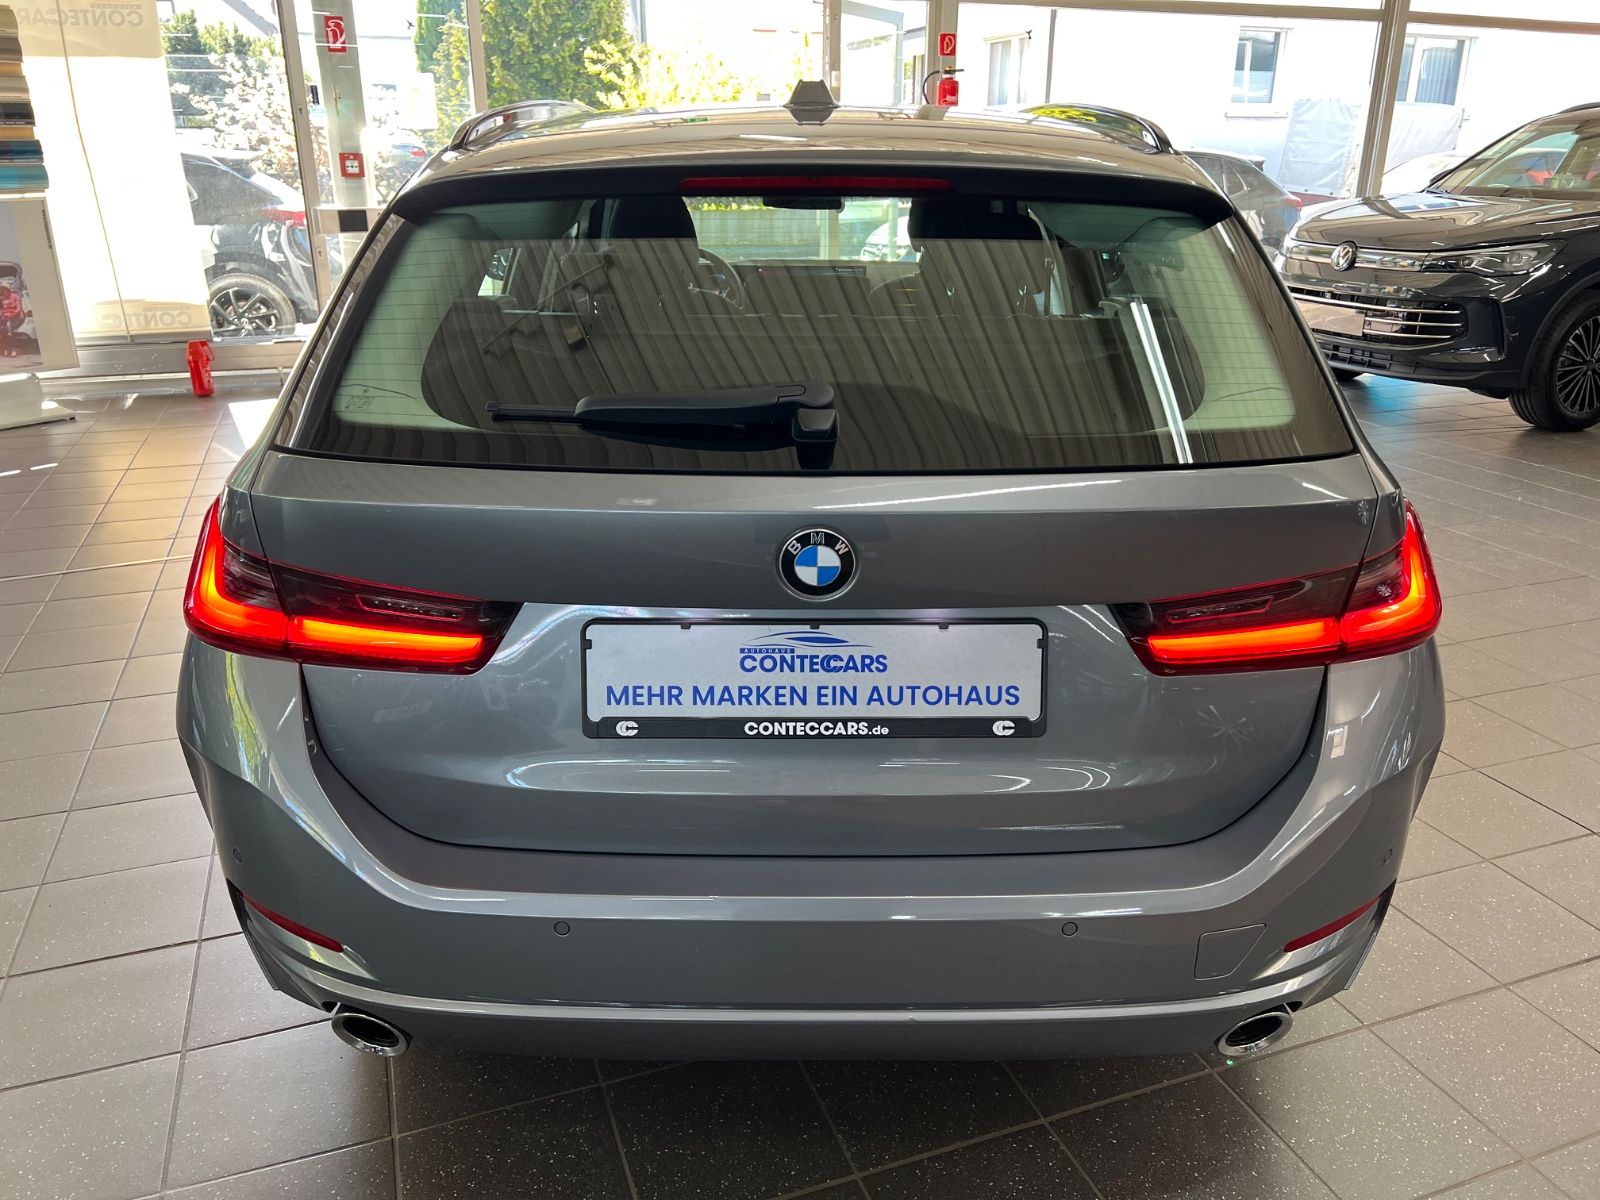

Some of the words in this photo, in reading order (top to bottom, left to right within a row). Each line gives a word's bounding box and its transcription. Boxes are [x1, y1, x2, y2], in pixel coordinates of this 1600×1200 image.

[787, 532, 849, 555] BMW
[739, 654, 888, 673] CONTECCARS
[606, 685, 684, 706] MEHR
[692, 685, 808, 706] MARKEN
[816, 685, 858, 706] EIN
[866, 685, 1020, 706] AUTOHAUS
[743, 721, 890, 736] CONTECCARS.de
